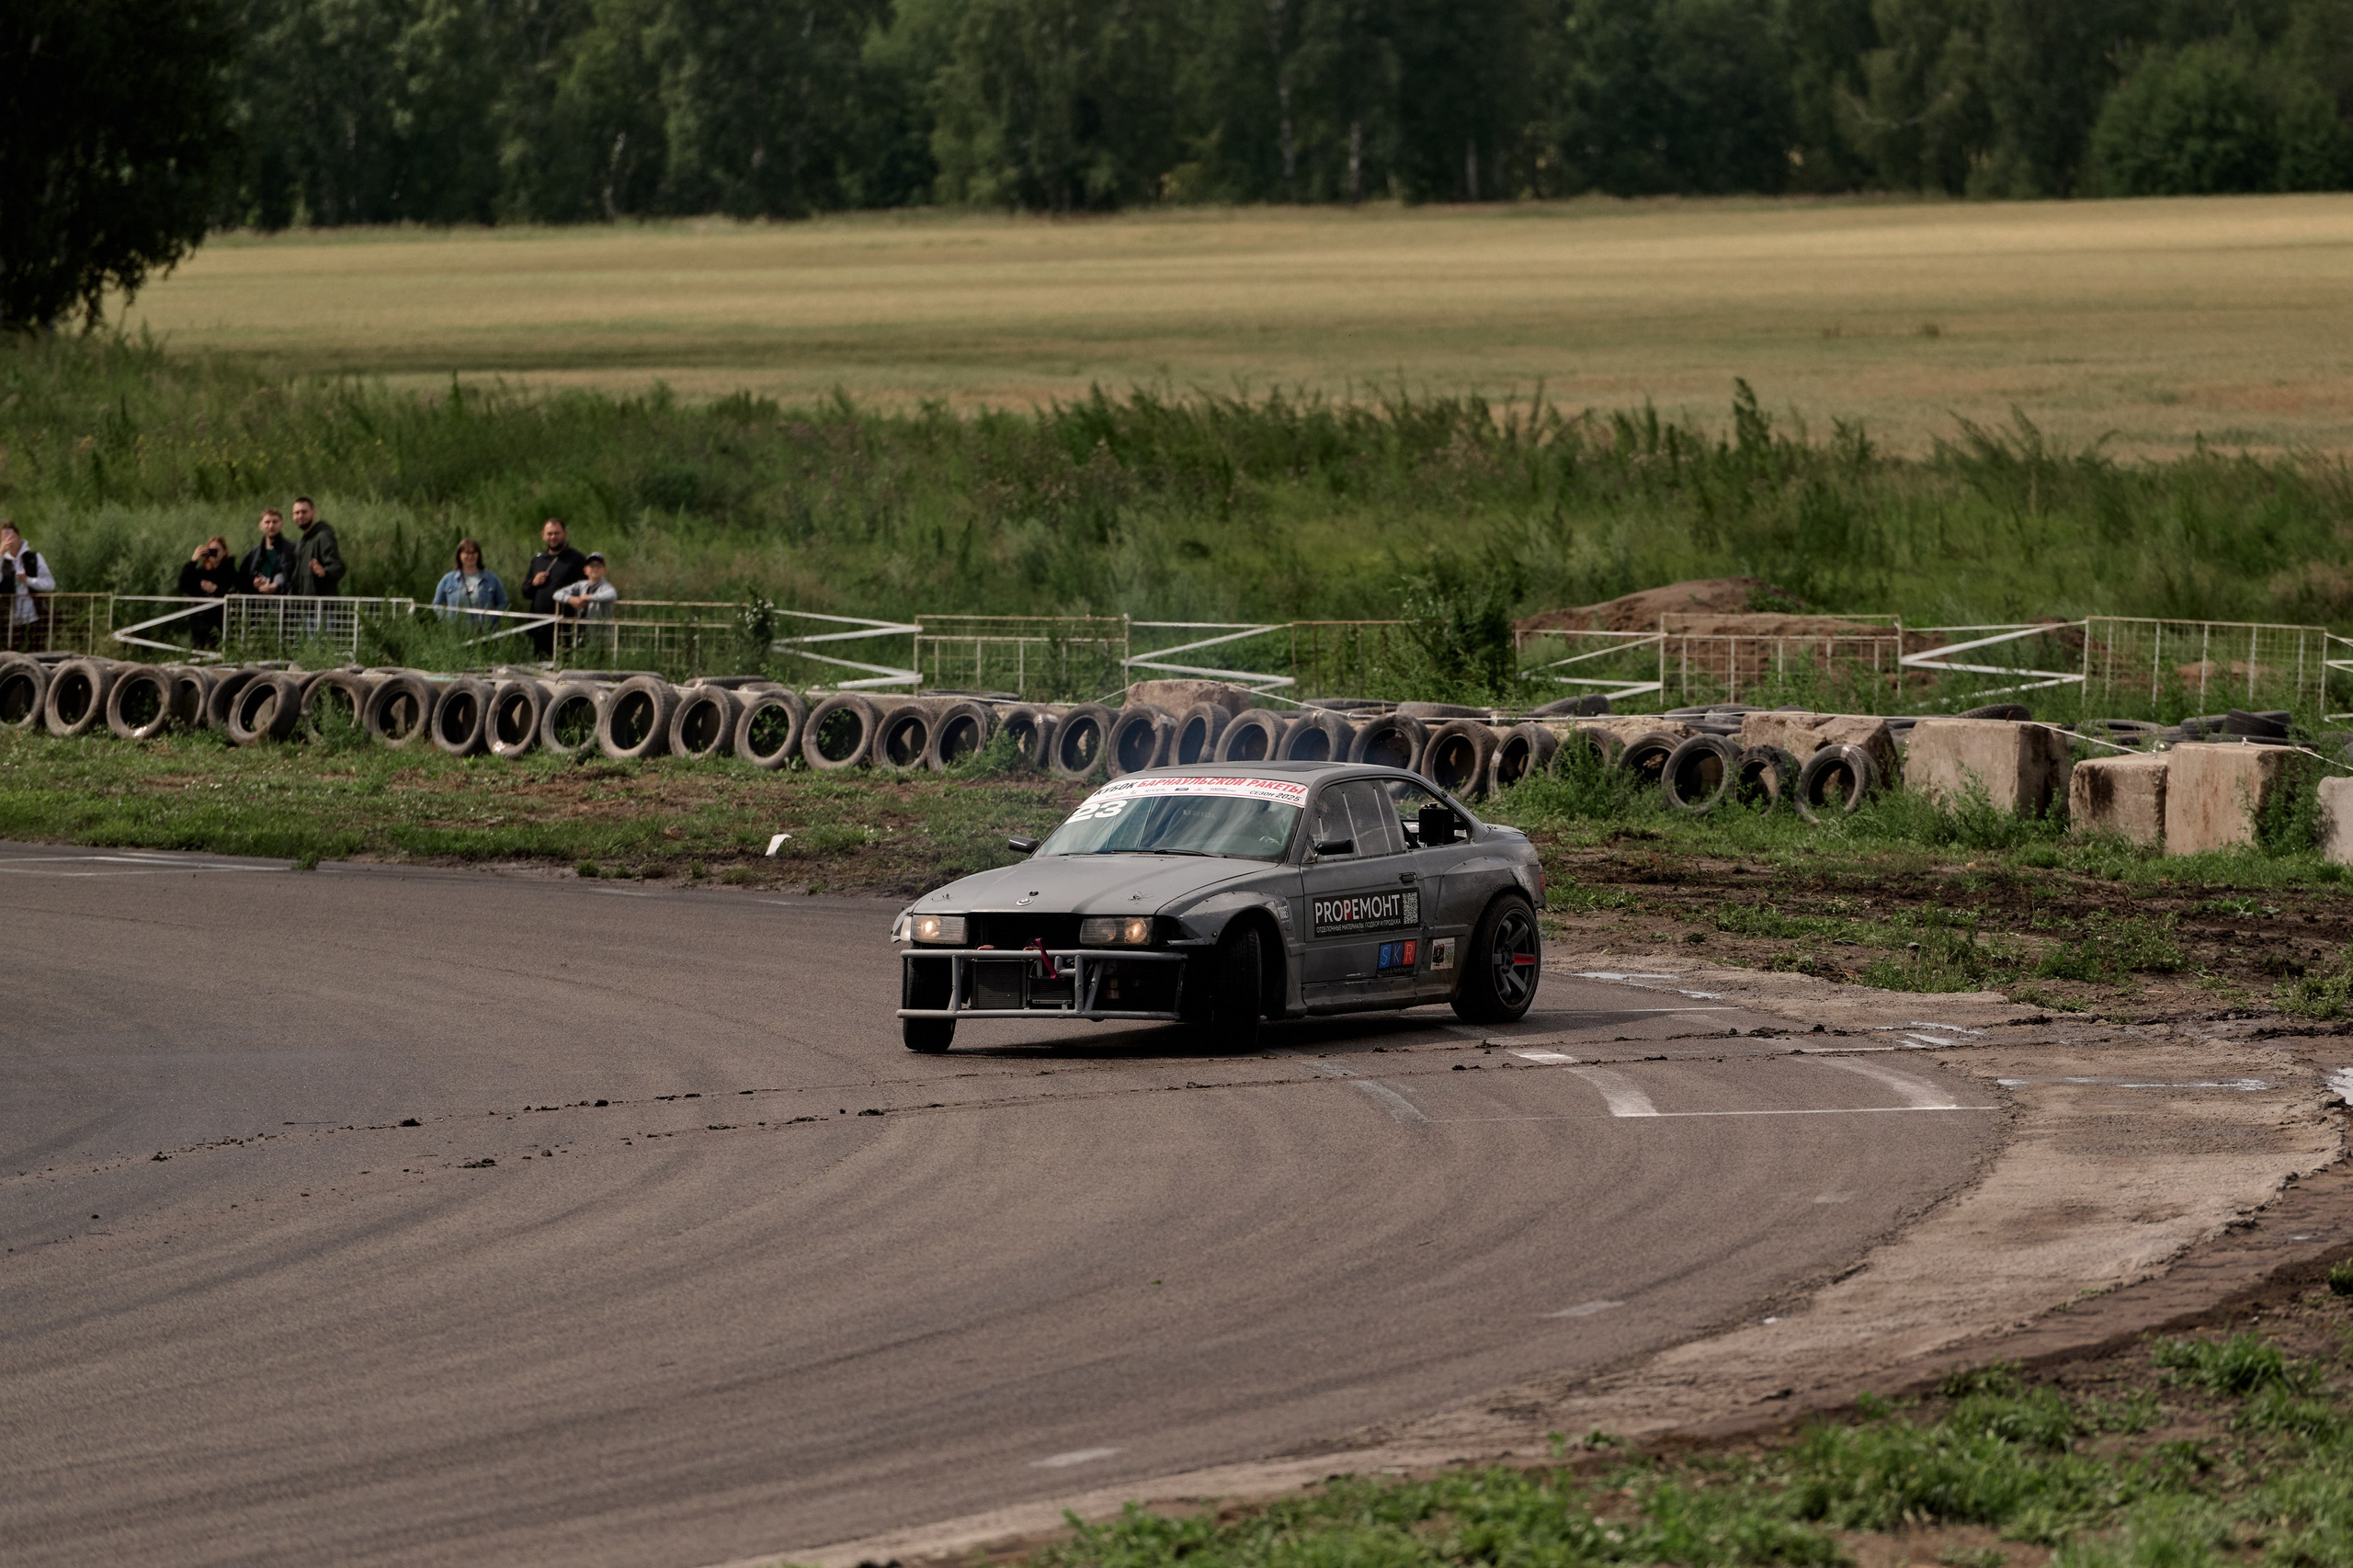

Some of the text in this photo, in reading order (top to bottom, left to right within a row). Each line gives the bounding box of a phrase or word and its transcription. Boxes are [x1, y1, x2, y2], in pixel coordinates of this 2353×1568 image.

[1093, 781, 1138, 796] КУБОК
[1246, 779, 1306, 794] РАКЕТЫ
[1275, 792, 1302, 801] 2025
[1064, 800, 1128, 824] 23
[1381, 944, 1415, 965] SKR
